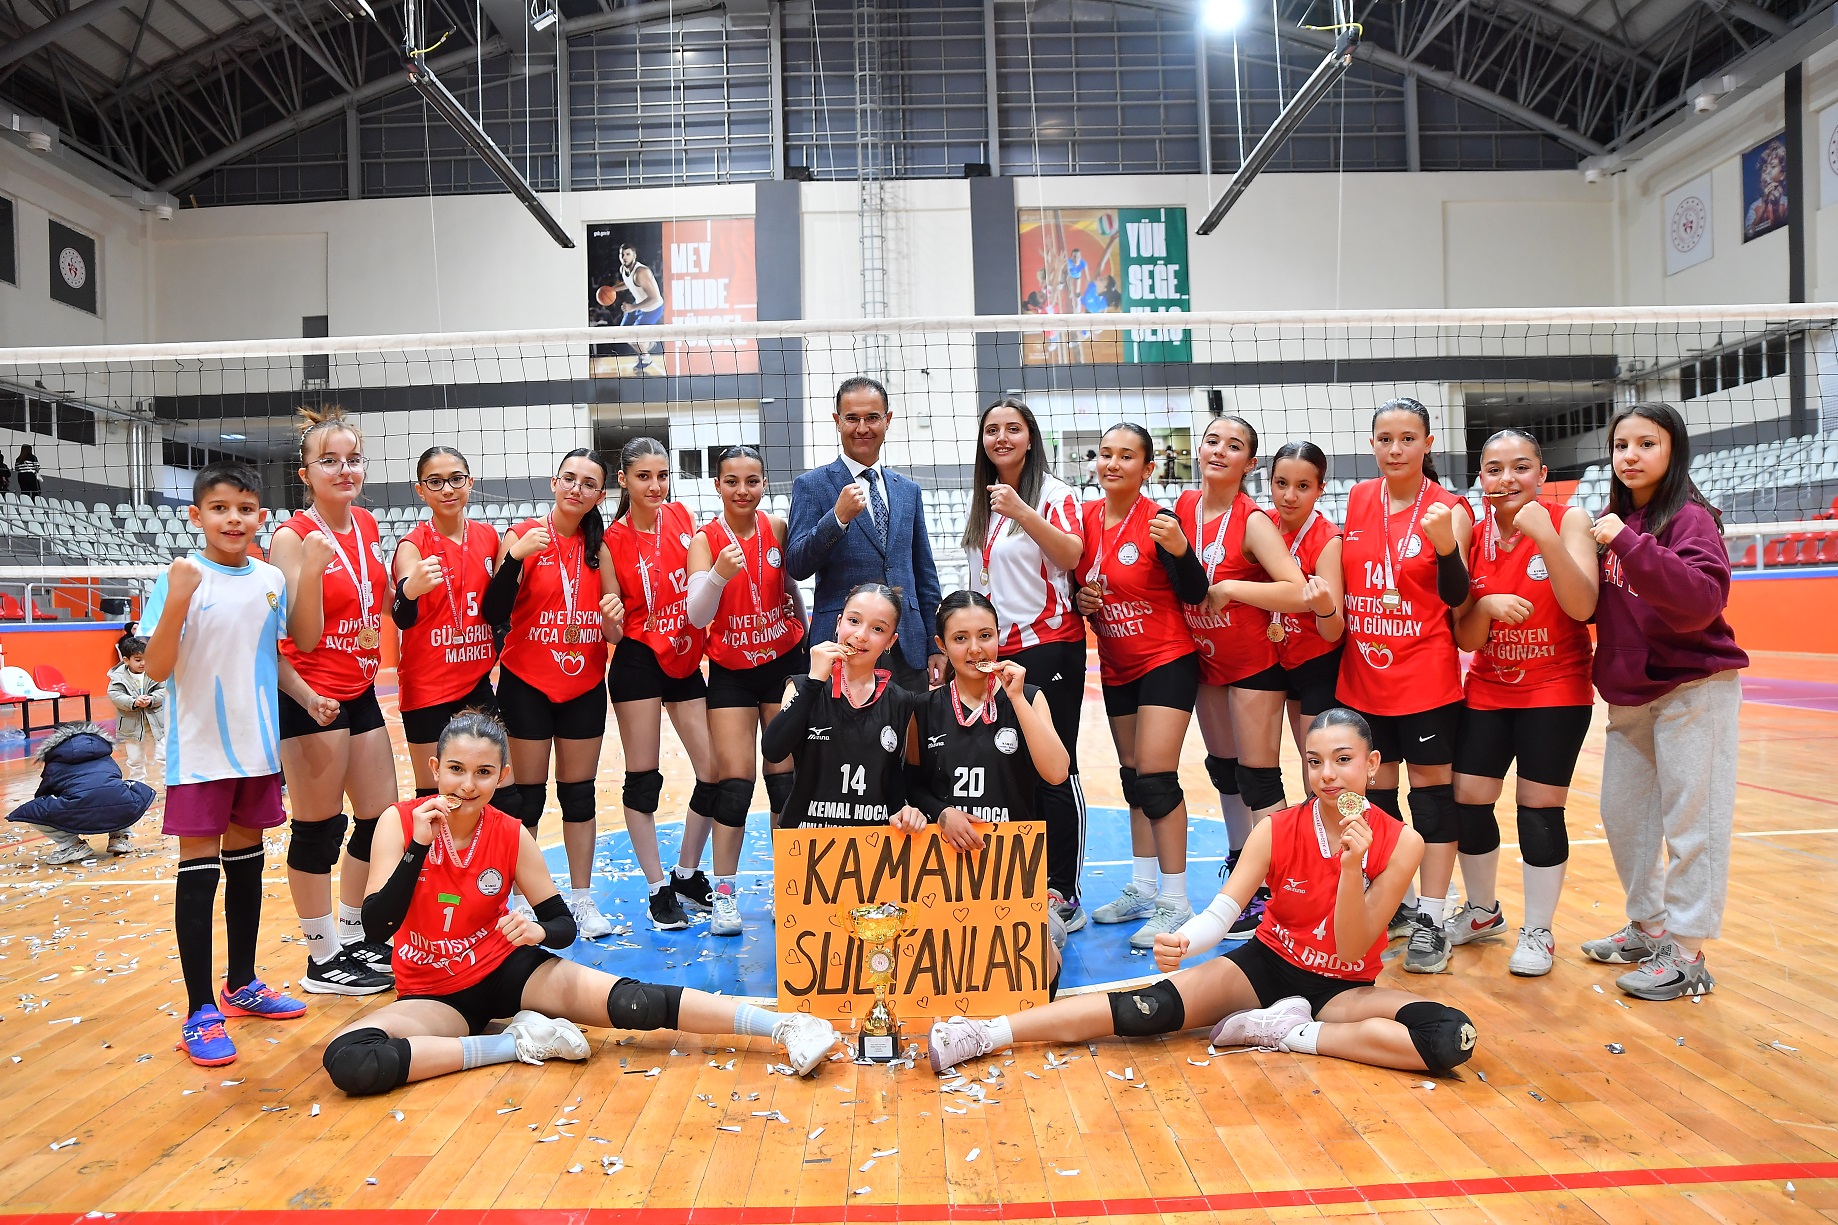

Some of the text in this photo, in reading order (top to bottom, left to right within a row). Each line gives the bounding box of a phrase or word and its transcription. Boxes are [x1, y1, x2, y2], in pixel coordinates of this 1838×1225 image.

[1126, 219, 1167, 258] YÜK
[671, 243, 711, 274] MEV
[668, 568, 688, 594] 12
[1364, 560, 1384, 590] 14
[466, 592, 479, 617] 5
[1364, 615, 1422, 637] GÜNDAY
[445, 644, 492, 663] MARKET
[841, 764, 866, 796] 14
[953, 766, 985, 798] 20
[808, 800, 888, 820] KEMAL HOCA
[442, 906, 454, 932] 1
[1312, 915, 1328, 940] 4
